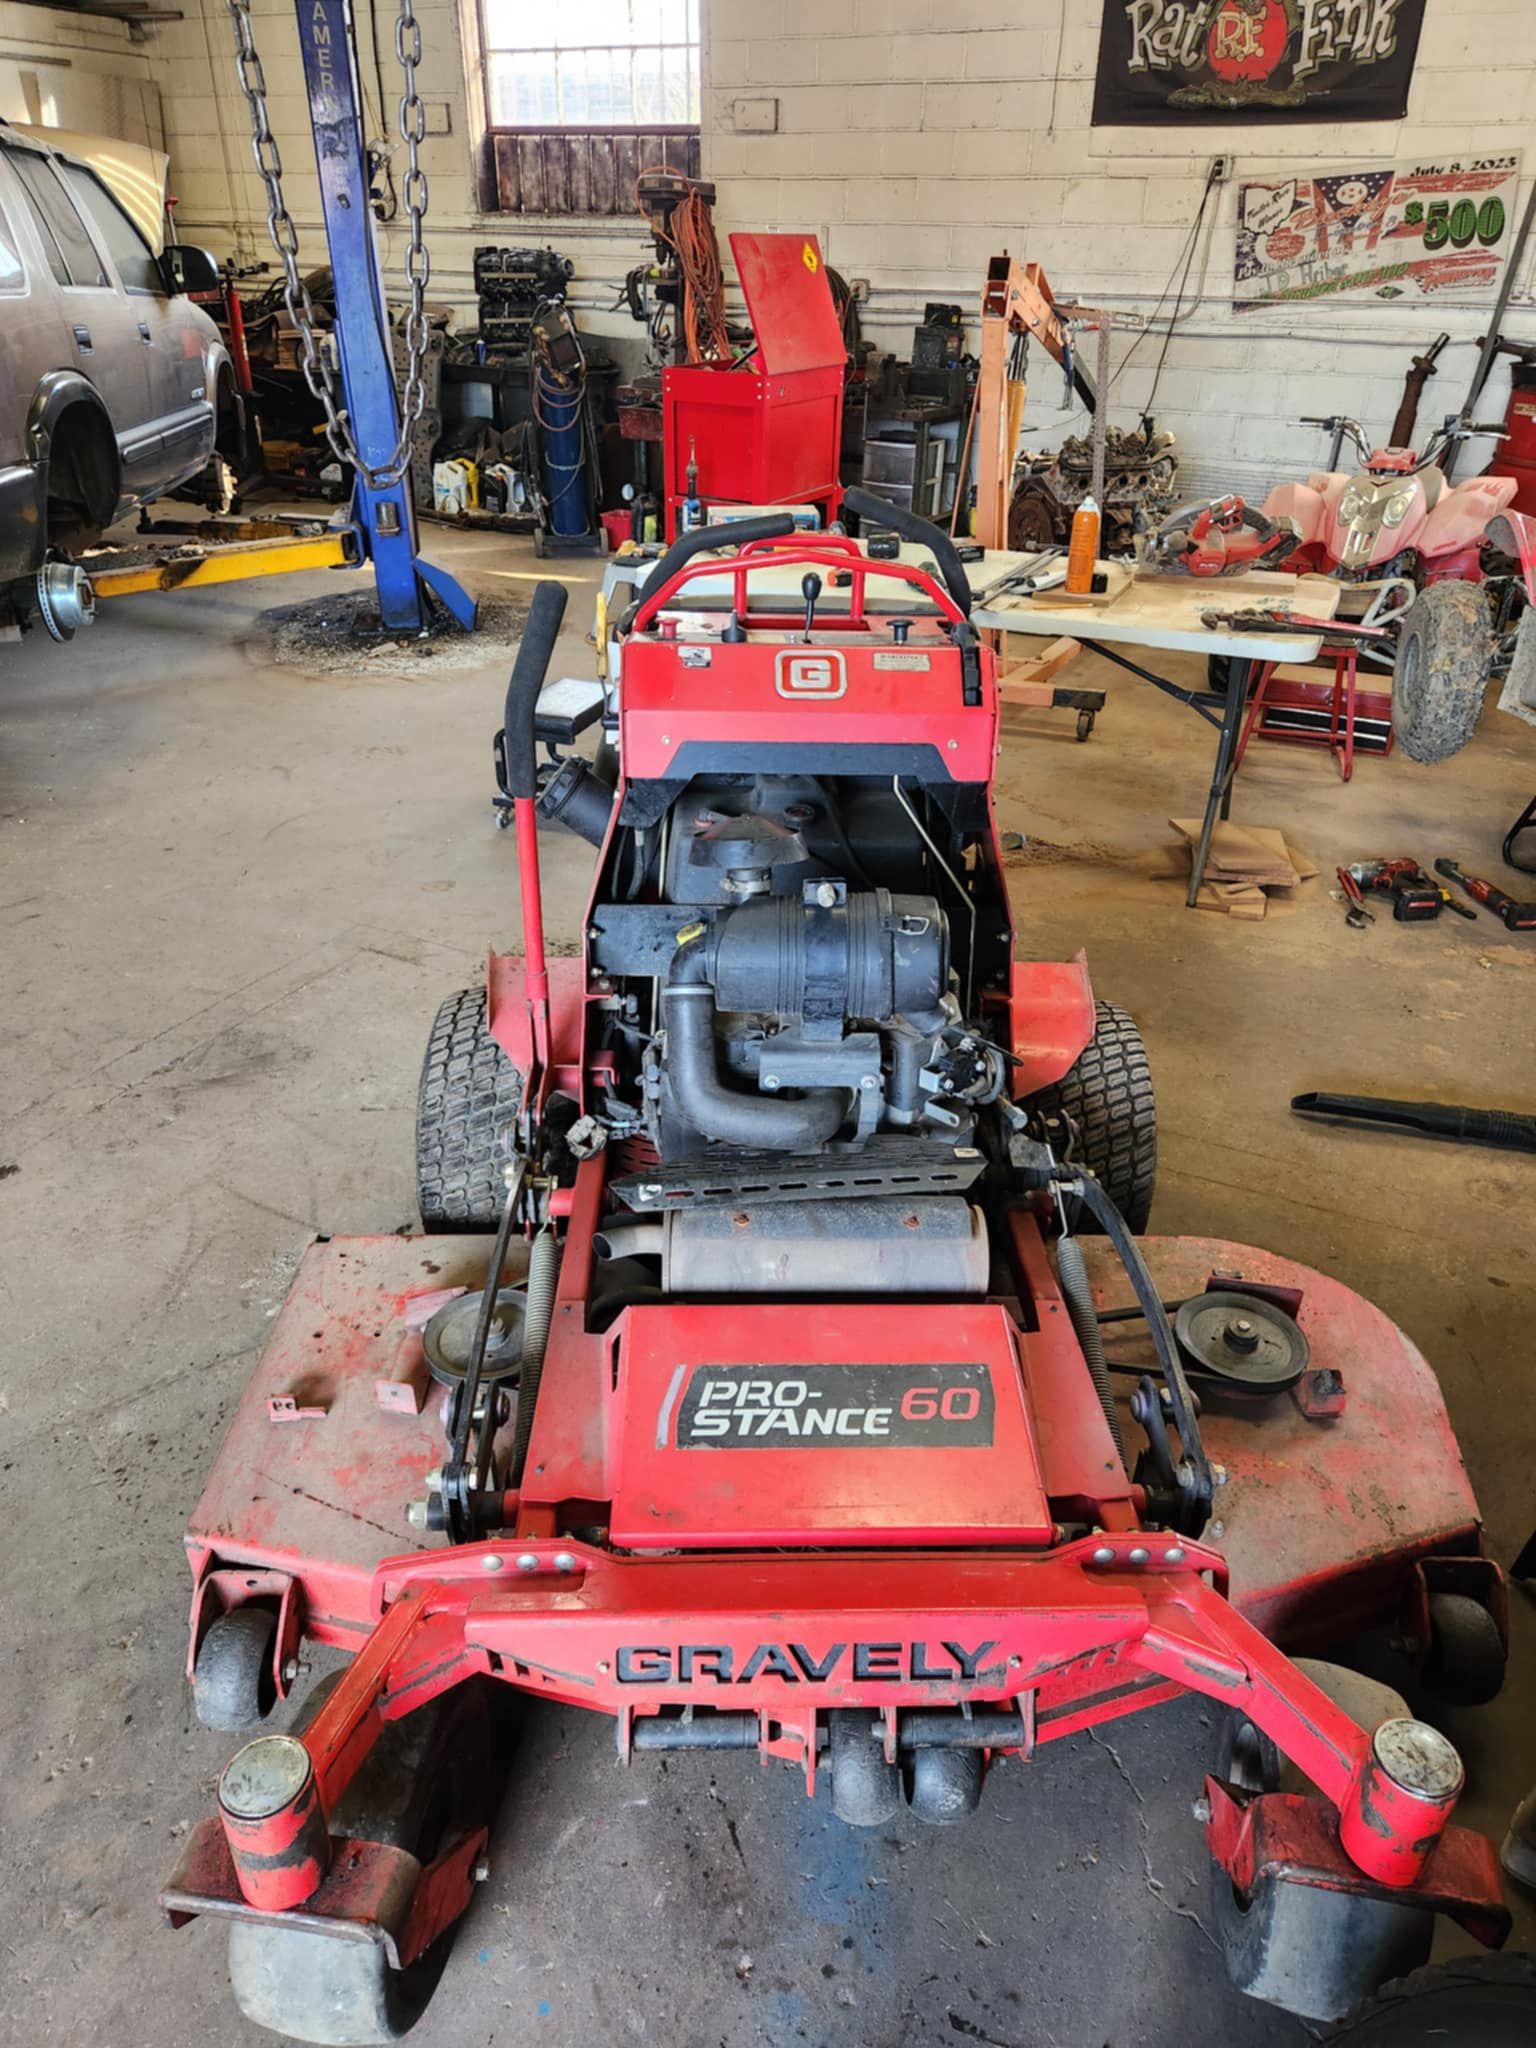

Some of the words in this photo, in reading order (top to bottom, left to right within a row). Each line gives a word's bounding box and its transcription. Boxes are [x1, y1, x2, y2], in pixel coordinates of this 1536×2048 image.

[1125, 1, 1206, 70] Rat
[1292, 0, 1398, 72] Fink
[1409, 165, 1444, 177] July
[1450, 162, 1465, 174] 8,
[1470, 156, 1518, 171] 2023
[1404, 196, 1505, 250] $500
[699, 1381, 822, 1407] PRO-
[901, 1388, 980, 1420] 60
[691, 1408, 893, 1436] STANCE
[615, 1641, 1001, 1683] GRAVELY
